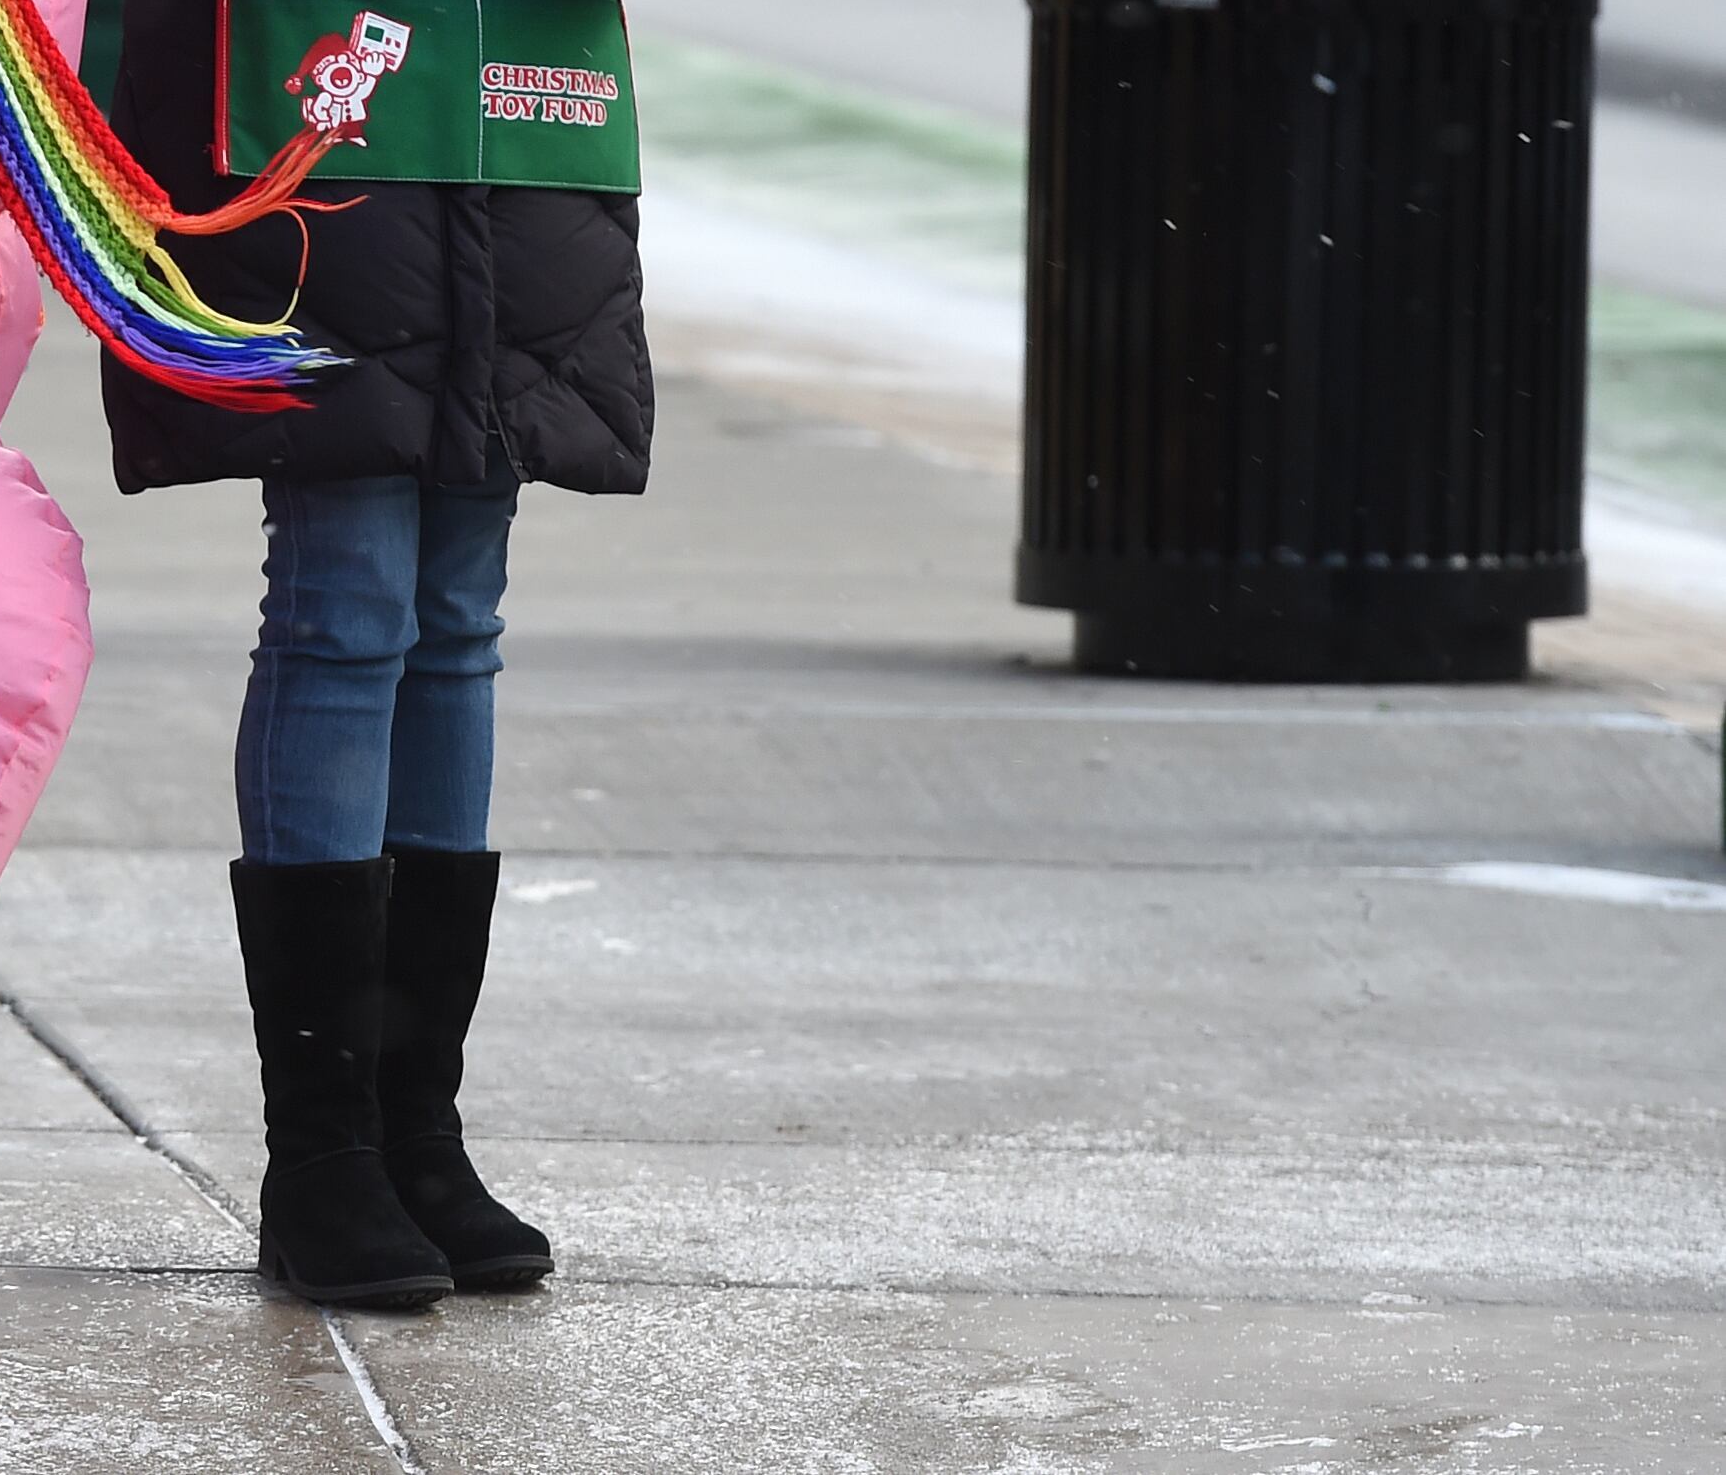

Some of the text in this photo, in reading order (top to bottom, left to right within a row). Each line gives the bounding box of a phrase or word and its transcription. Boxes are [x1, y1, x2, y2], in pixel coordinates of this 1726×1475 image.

[480, 61, 619, 101] CHRISTMAS
[481, 91, 609, 127] TOY FUND
